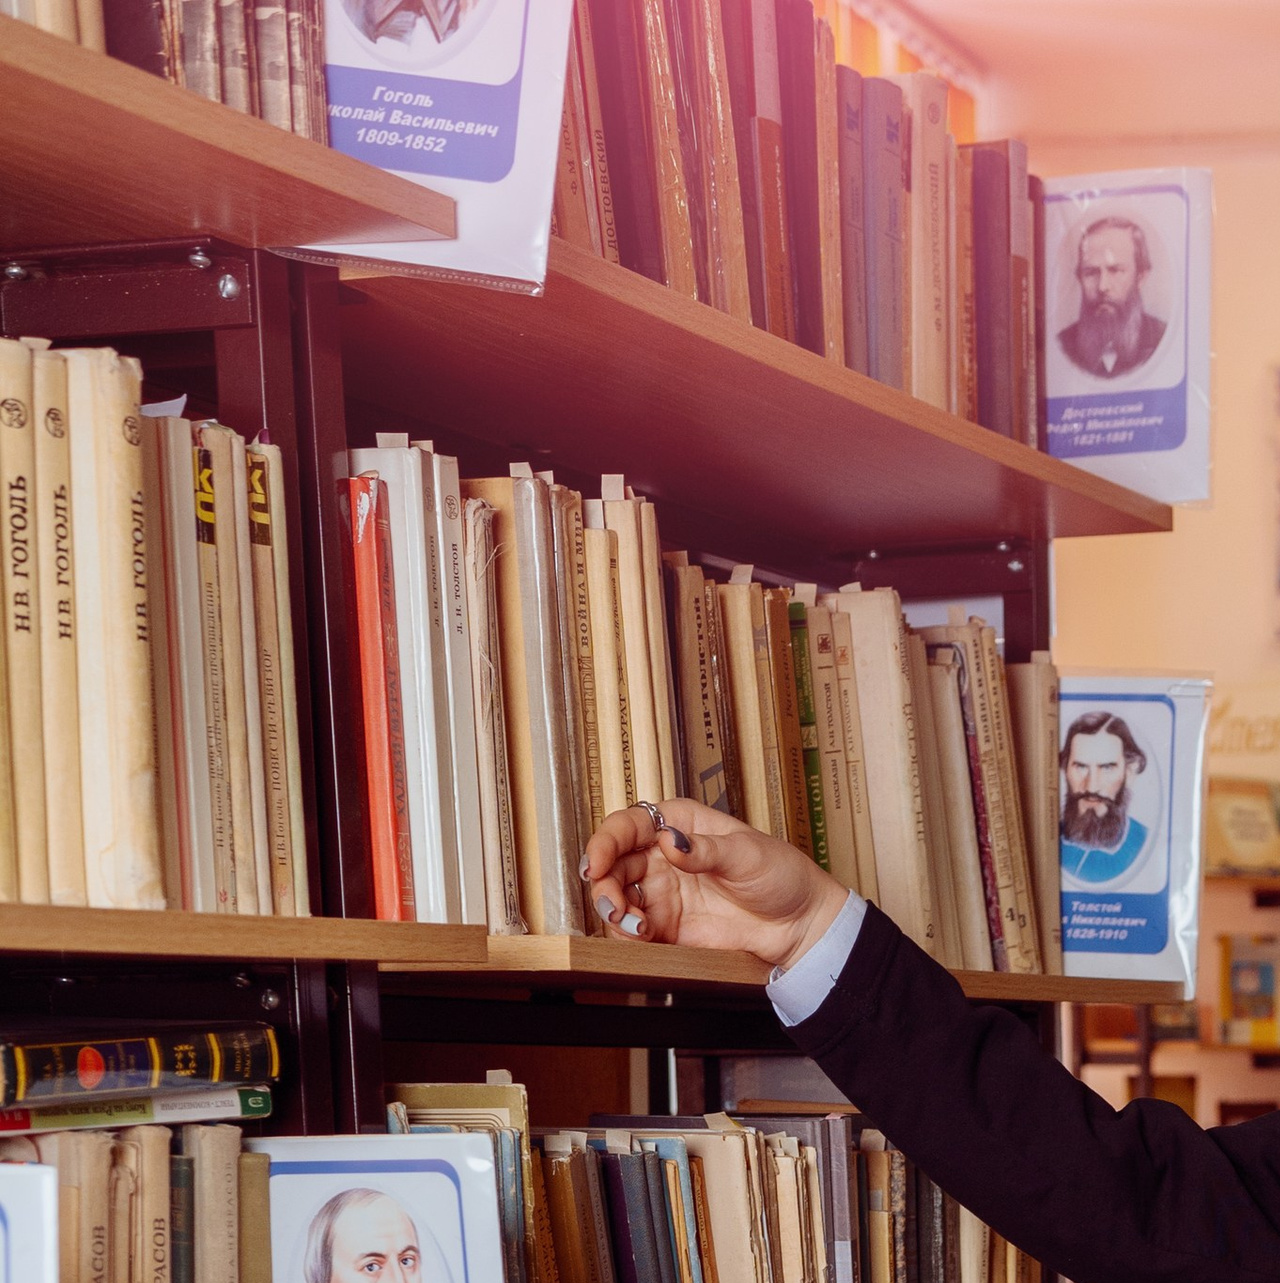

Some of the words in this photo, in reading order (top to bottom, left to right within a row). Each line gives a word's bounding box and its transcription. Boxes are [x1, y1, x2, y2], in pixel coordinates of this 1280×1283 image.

[372, 86, 435, 107] Гоголь
[389, 110, 499, 137] Васильевич
[356, 128, 446, 153] 1809-1852
[8, 475, 30, 579] ГОГОЛЬ
[53, 483, 71, 587] ГОГОЛЬ
[131, 491, 146, 588] ГОГОЛЬ
[573, 511, 584, 557] МИР
[575, 562, 584, 576] И
[13, 589, 31, 634] Н.В.
[577, 581, 589, 648] ВОЙНА
[1070, 914, 1148, 927] Николаевич
[1071, 901, 1123, 913] Толстой
[1066, 928, 1128, 940] 1828-1910
